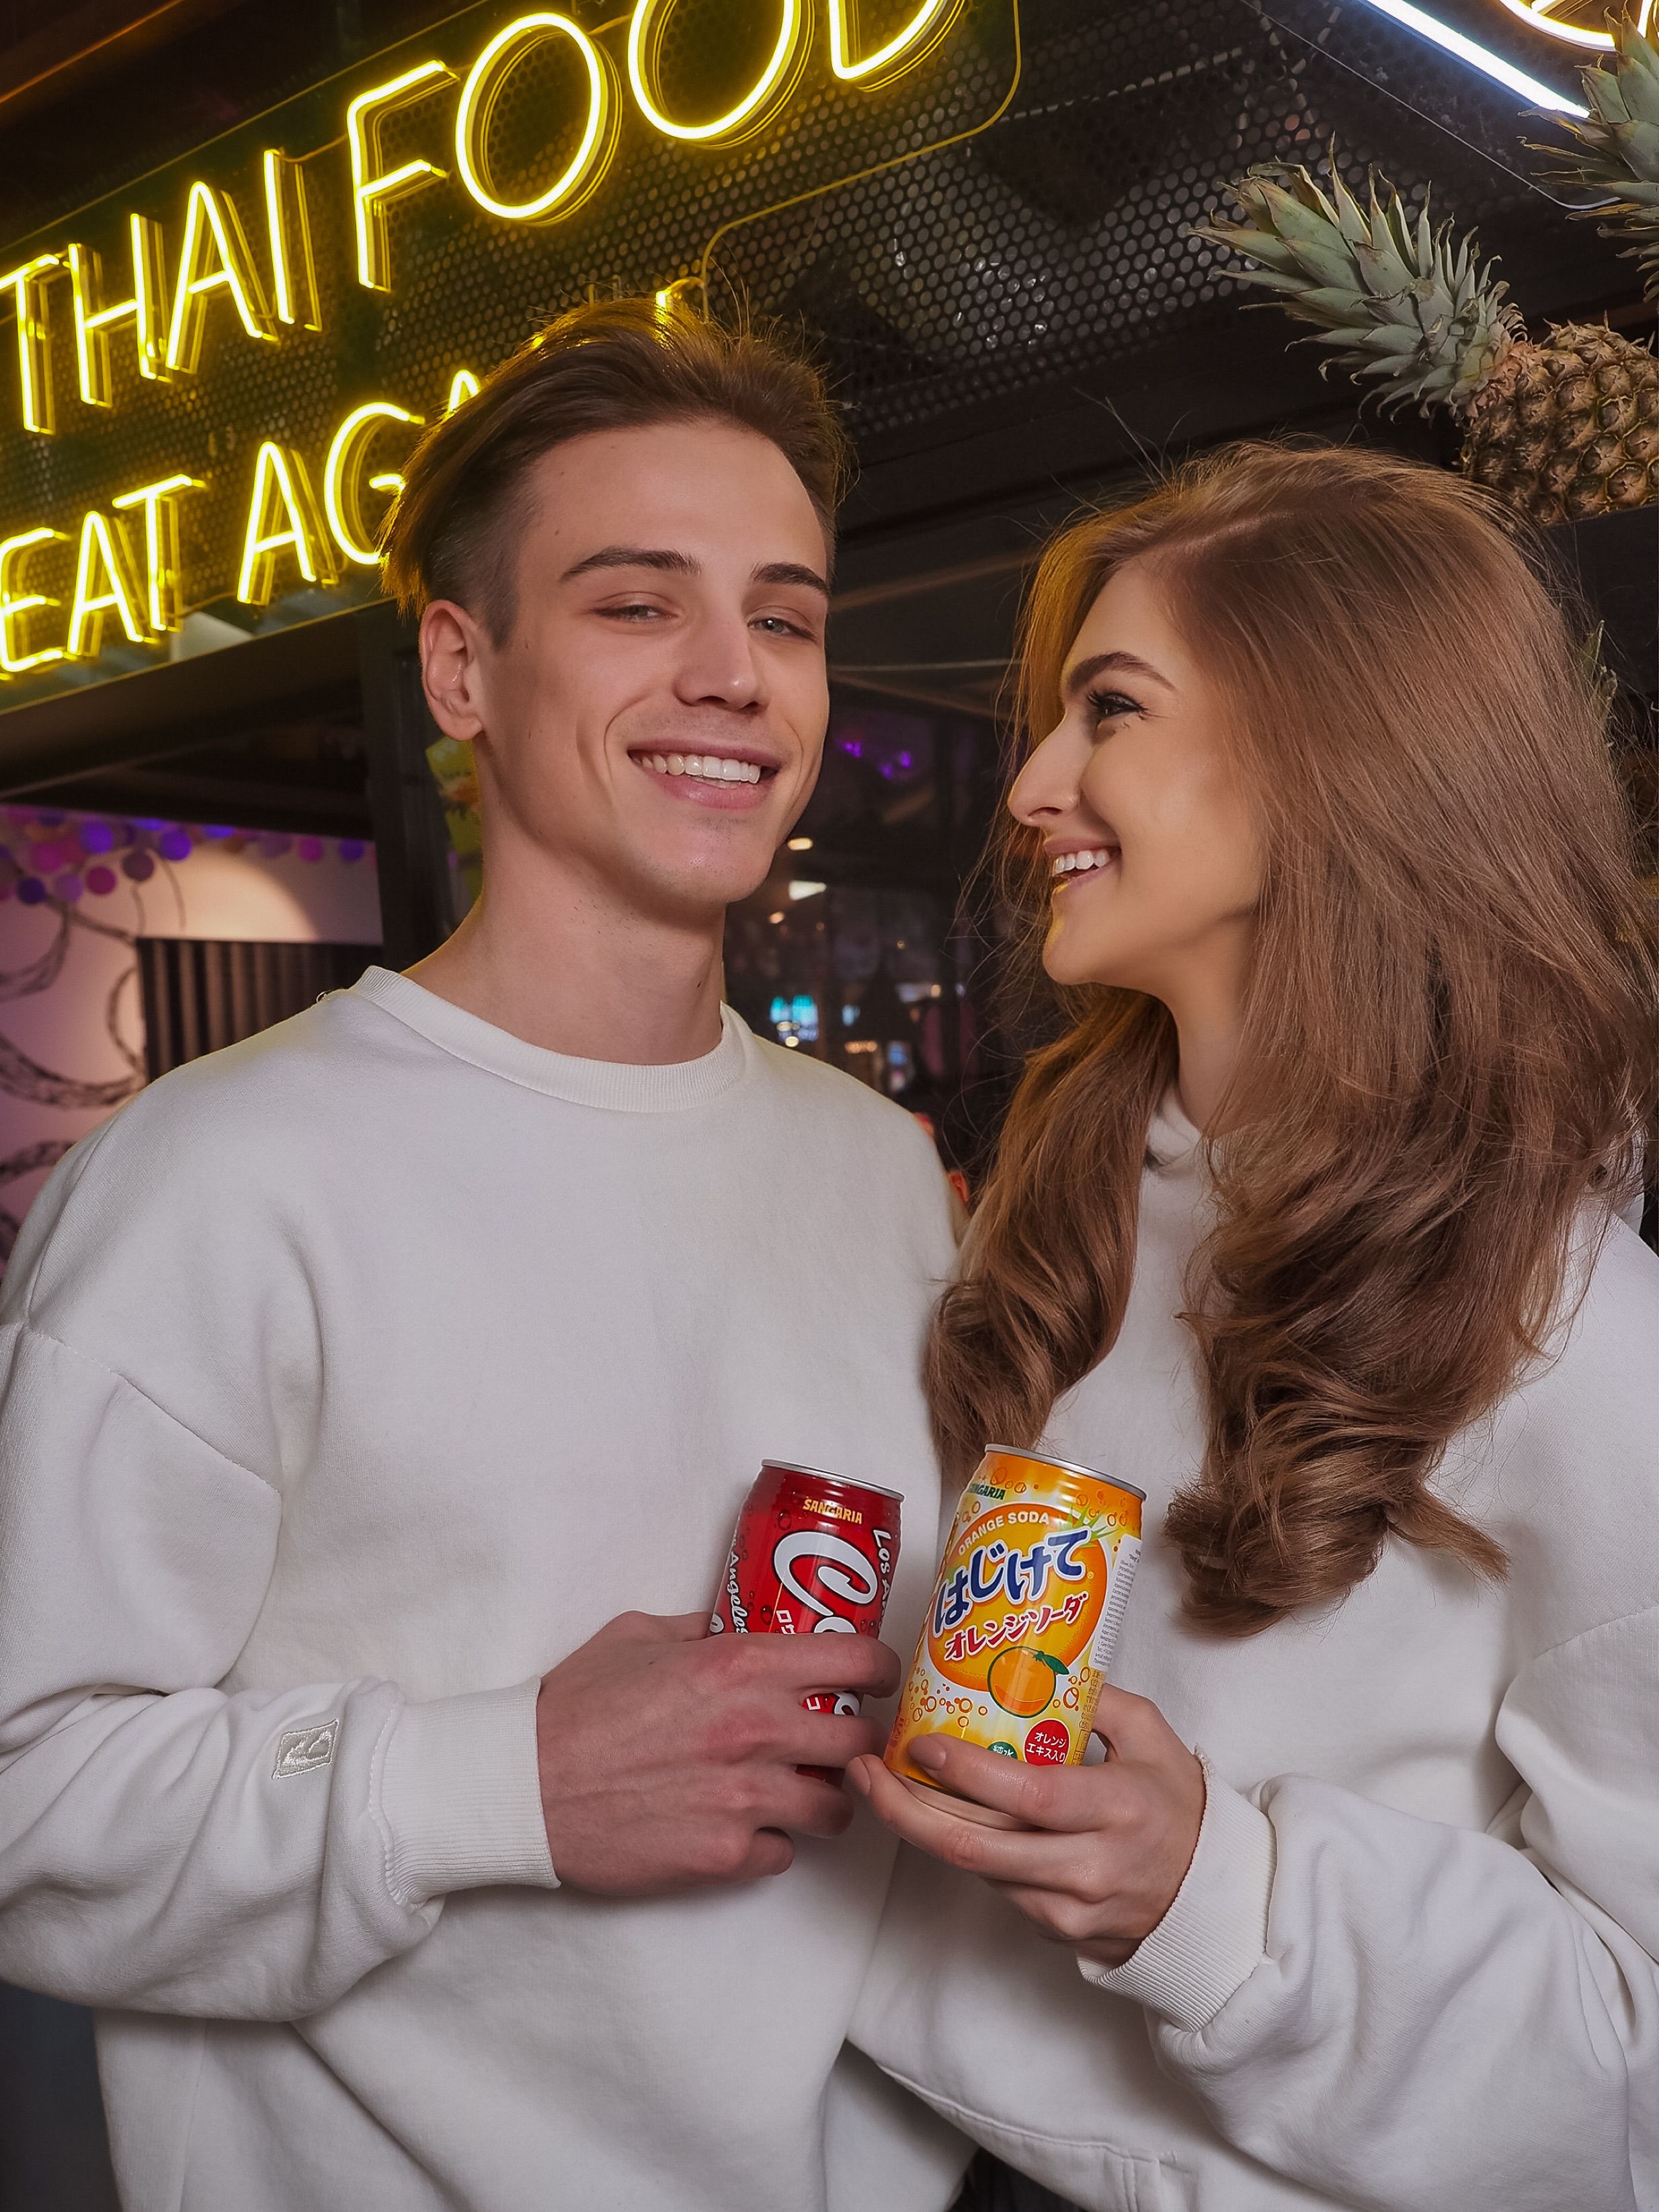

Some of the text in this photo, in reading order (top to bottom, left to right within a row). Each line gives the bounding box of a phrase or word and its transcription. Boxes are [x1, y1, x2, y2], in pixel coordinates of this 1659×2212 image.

[0, 149, 302, 433] THAI
[0, 474, 199, 672] EAT
[802, 1499, 862, 1525] SANGARIA
[959, 1511, 1049, 1556] ORANGE SODA
[934, 1530, 1089, 1635] はじけて
[944, 1593, 1088, 1659] オレンジソーダ
[1026, 1743, 1066, 1763] エキス入り
[1034, 1731, 1067, 1748] オレンジ
